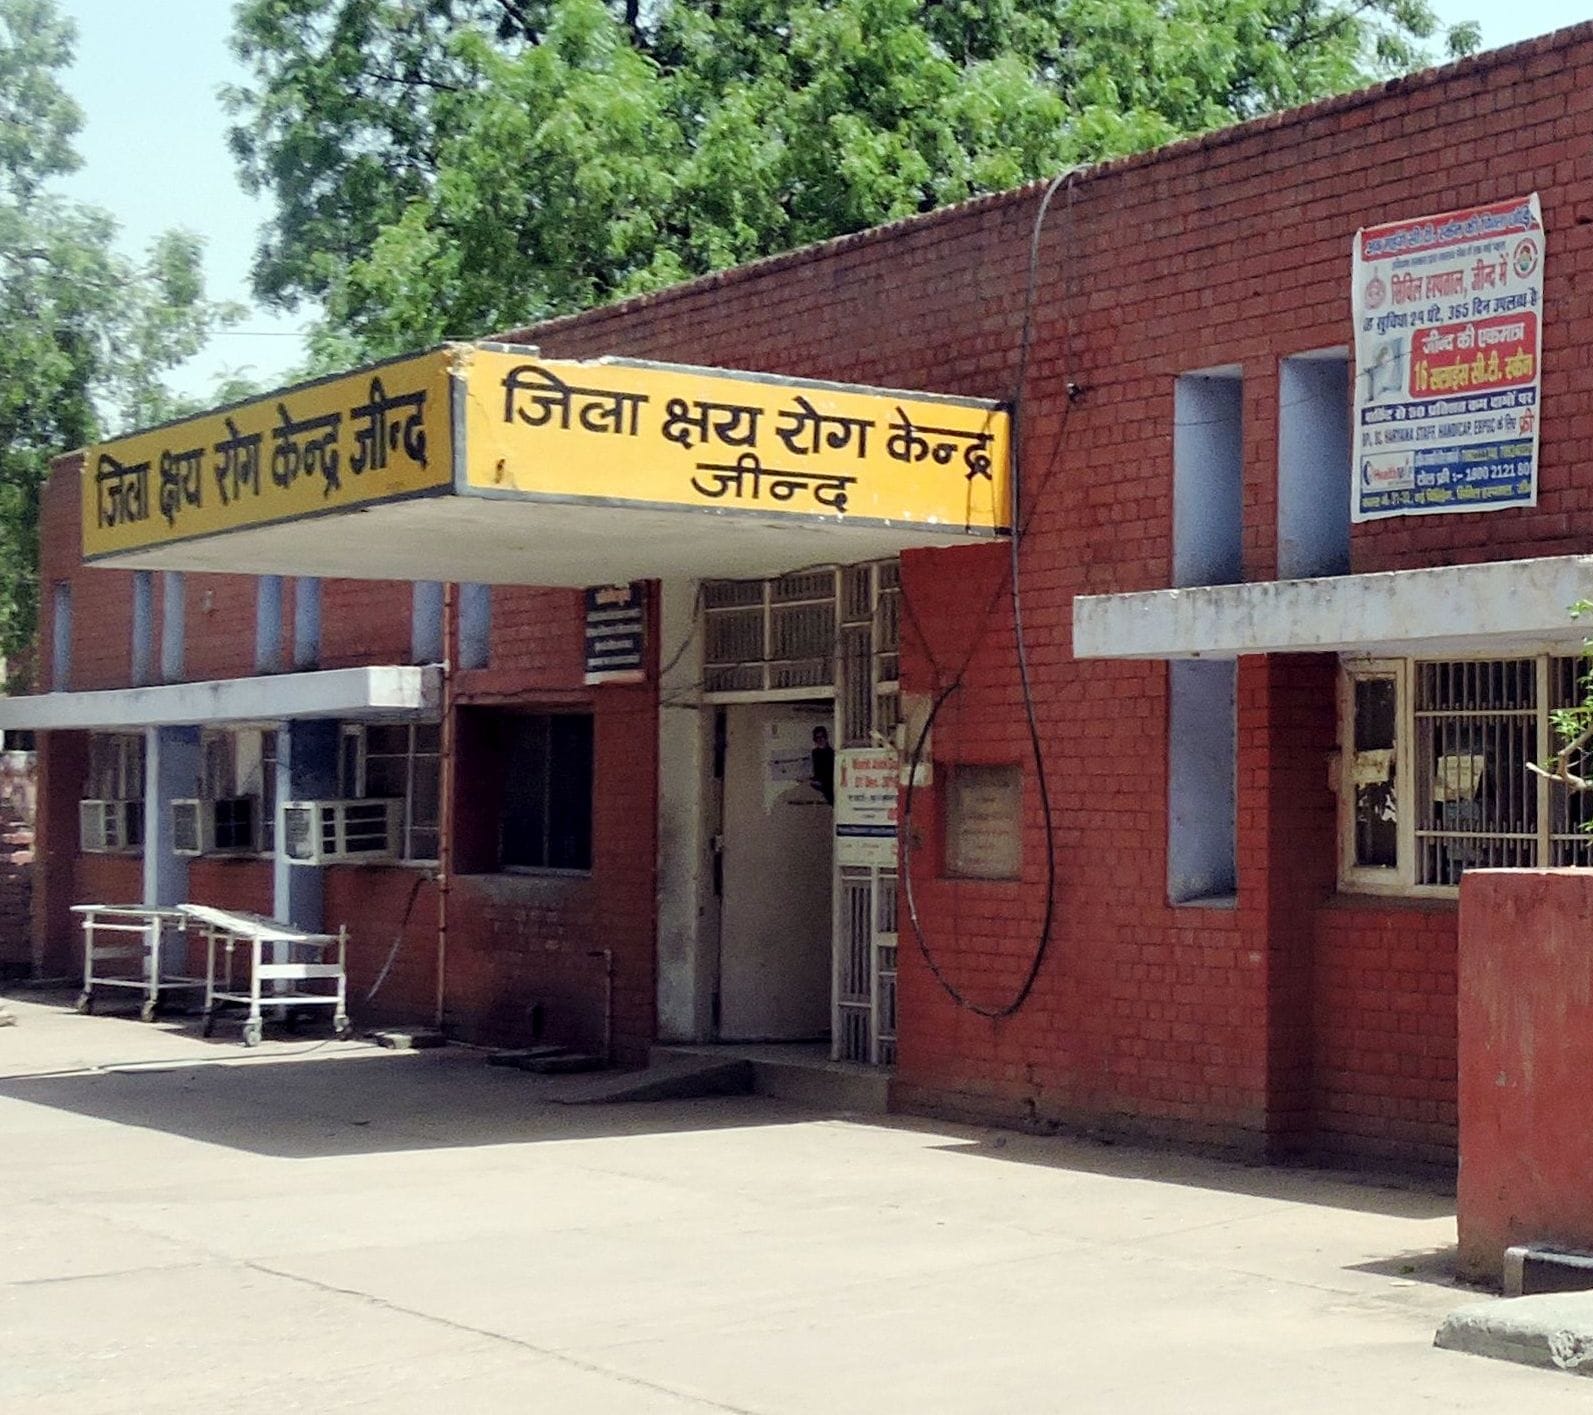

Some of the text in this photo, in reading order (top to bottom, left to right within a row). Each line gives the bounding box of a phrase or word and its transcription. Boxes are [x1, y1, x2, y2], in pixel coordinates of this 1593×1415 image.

[1498, 252, 1511, 287] में
[1447, 301, 1469, 321] 365
[1472, 296, 1491, 317] दिन
[1413, 359, 1430, 392] 16
[499, 363, 995, 481] जिला क्षय रोग केन्द्र
[95, 376, 428, 530] जिला क्षय रोग केन्द्र जीन्द
[1490, 463, 1515, 478] 2121
[691, 452, 858, 513] जीन्द
